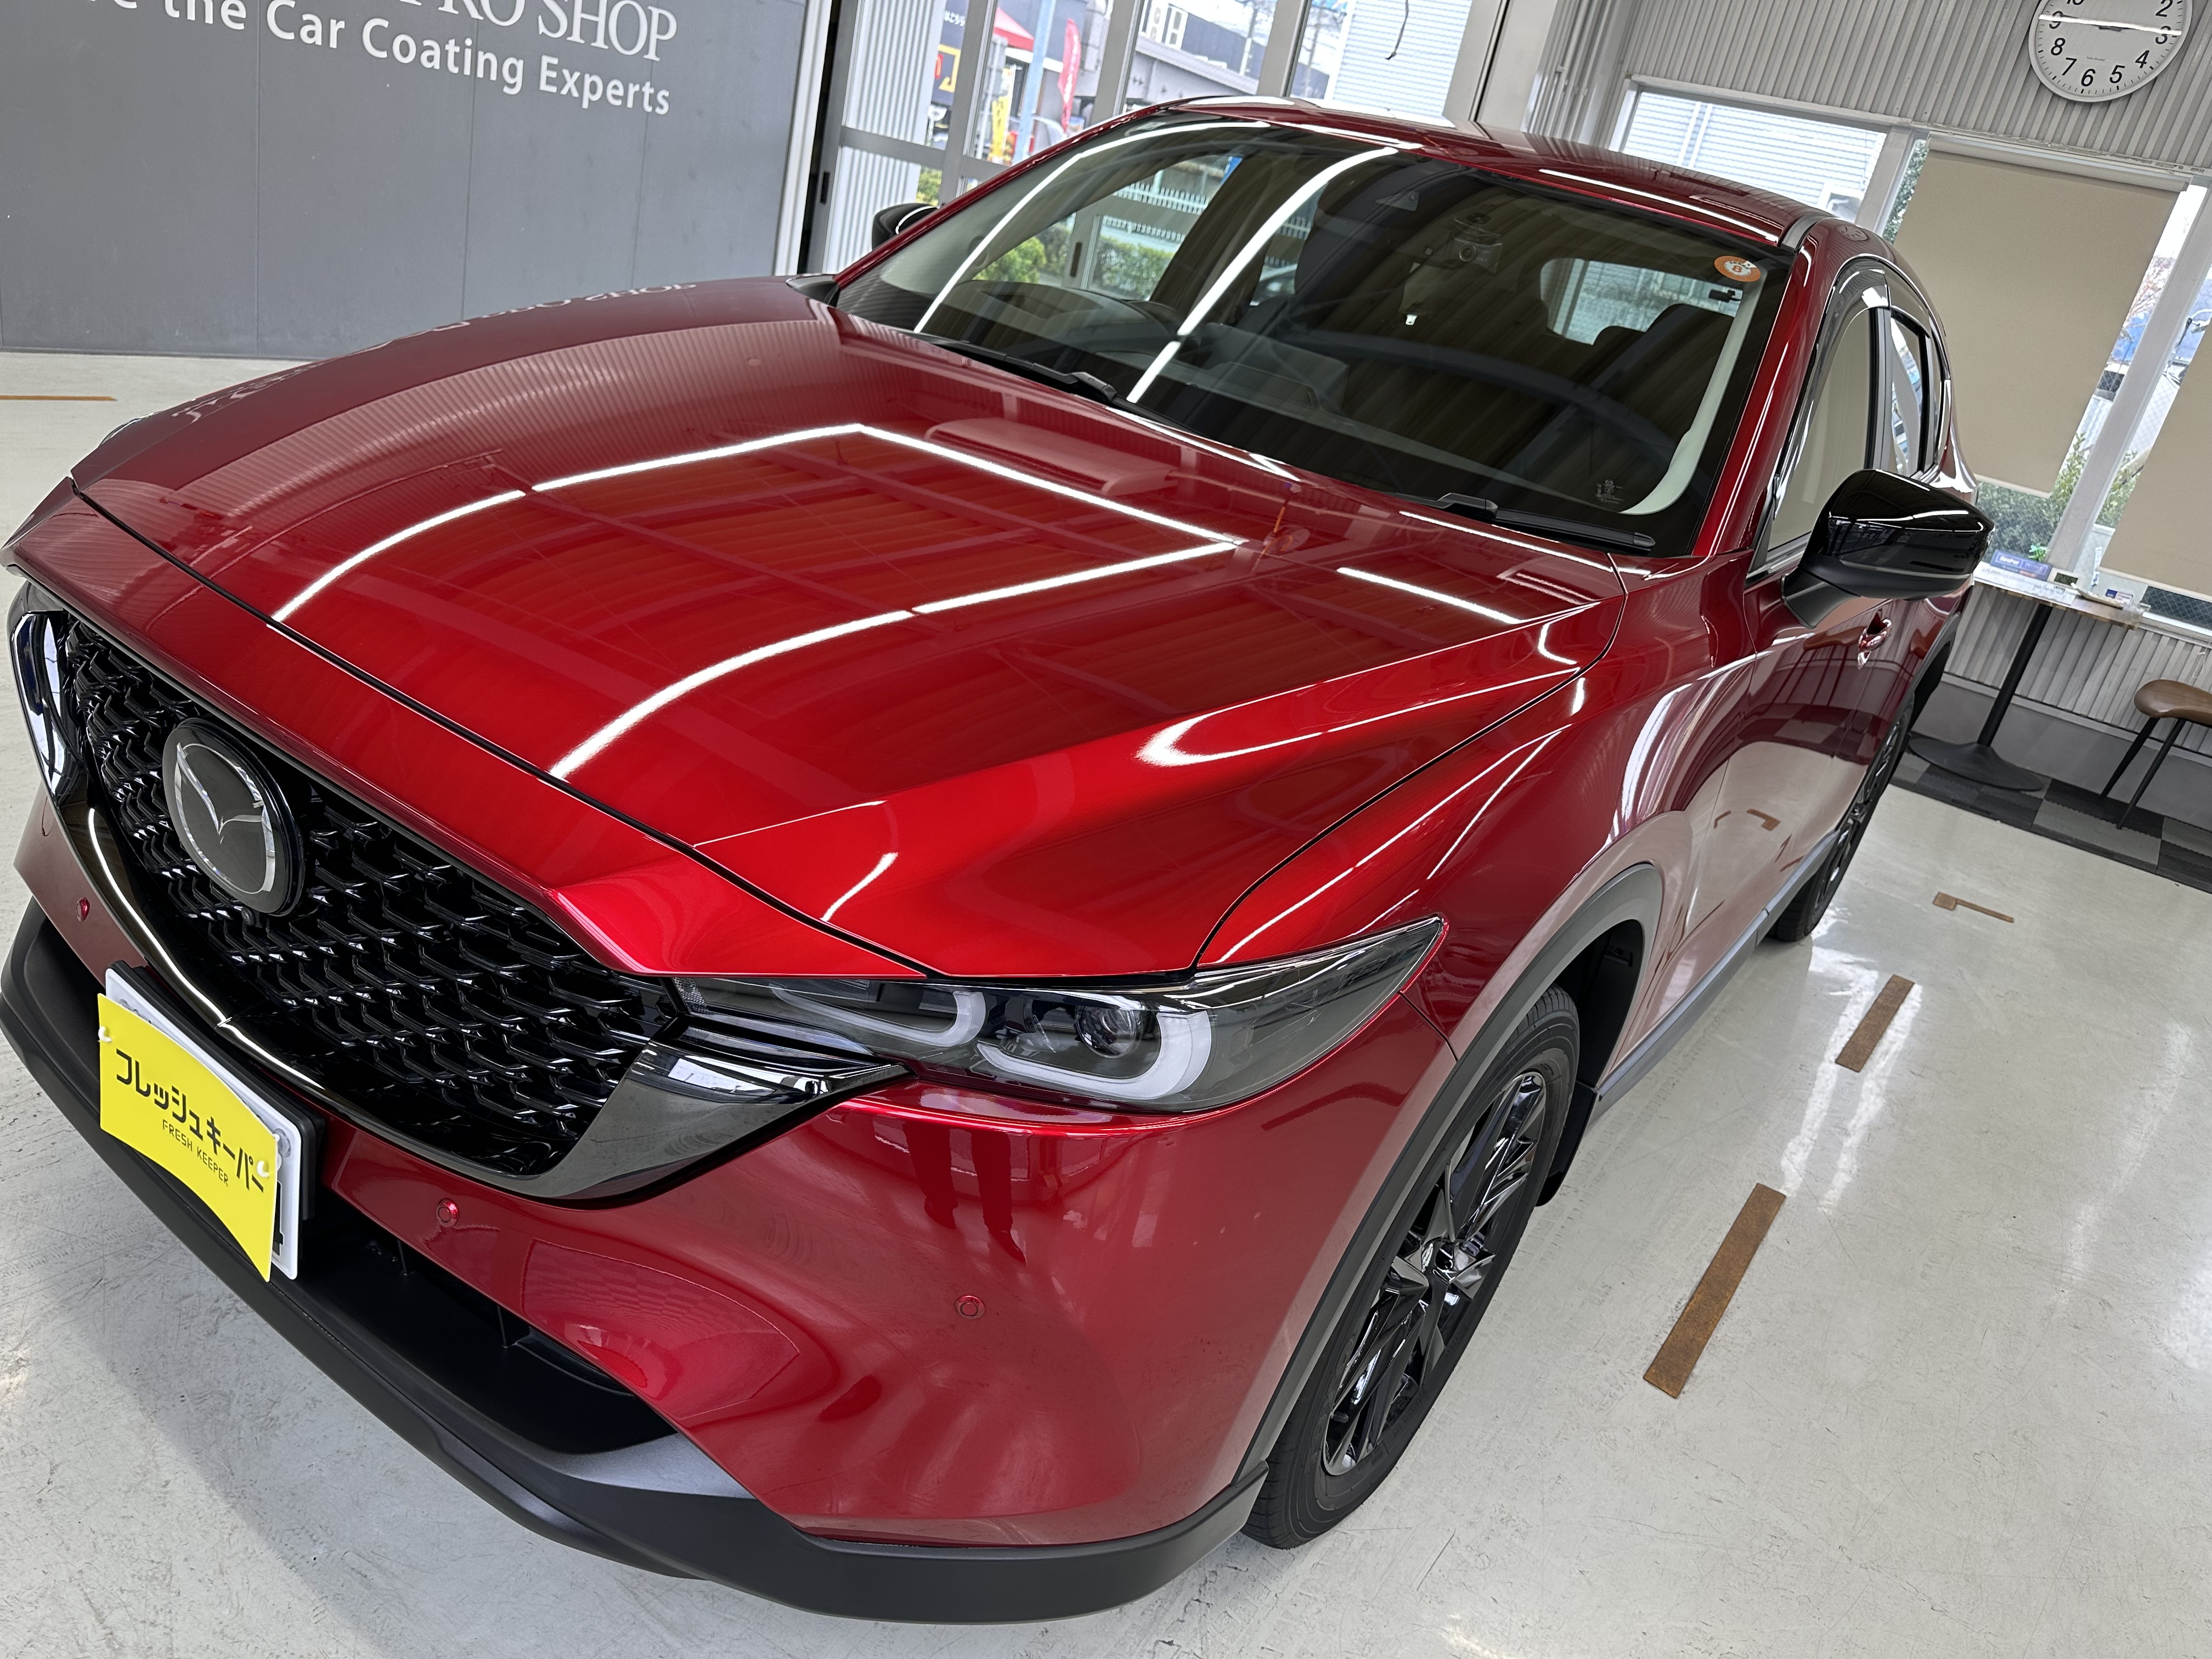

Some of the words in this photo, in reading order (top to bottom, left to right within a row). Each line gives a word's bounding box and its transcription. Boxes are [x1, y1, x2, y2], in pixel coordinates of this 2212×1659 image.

[2155, 0, 2173, 17] 2
[538, 0, 677, 61] SHOP
[2051, 38, 2066, 56] 8
[267, 0, 345, 48] Car
[362, 18, 523, 95] Coating
[539, 55, 670, 115] Experts
[2062, 57, 2077, 76] 7
[2135, 50, 2150, 69] 4
[2081, 69, 2096, 87] 6
[2109, 65, 2125, 83] 5
[116, 1048, 263, 1193] フレッシュキーパー
[162, 1119, 193, 1152] FRESH
[197, 1147, 229, 1187] KEEPER
